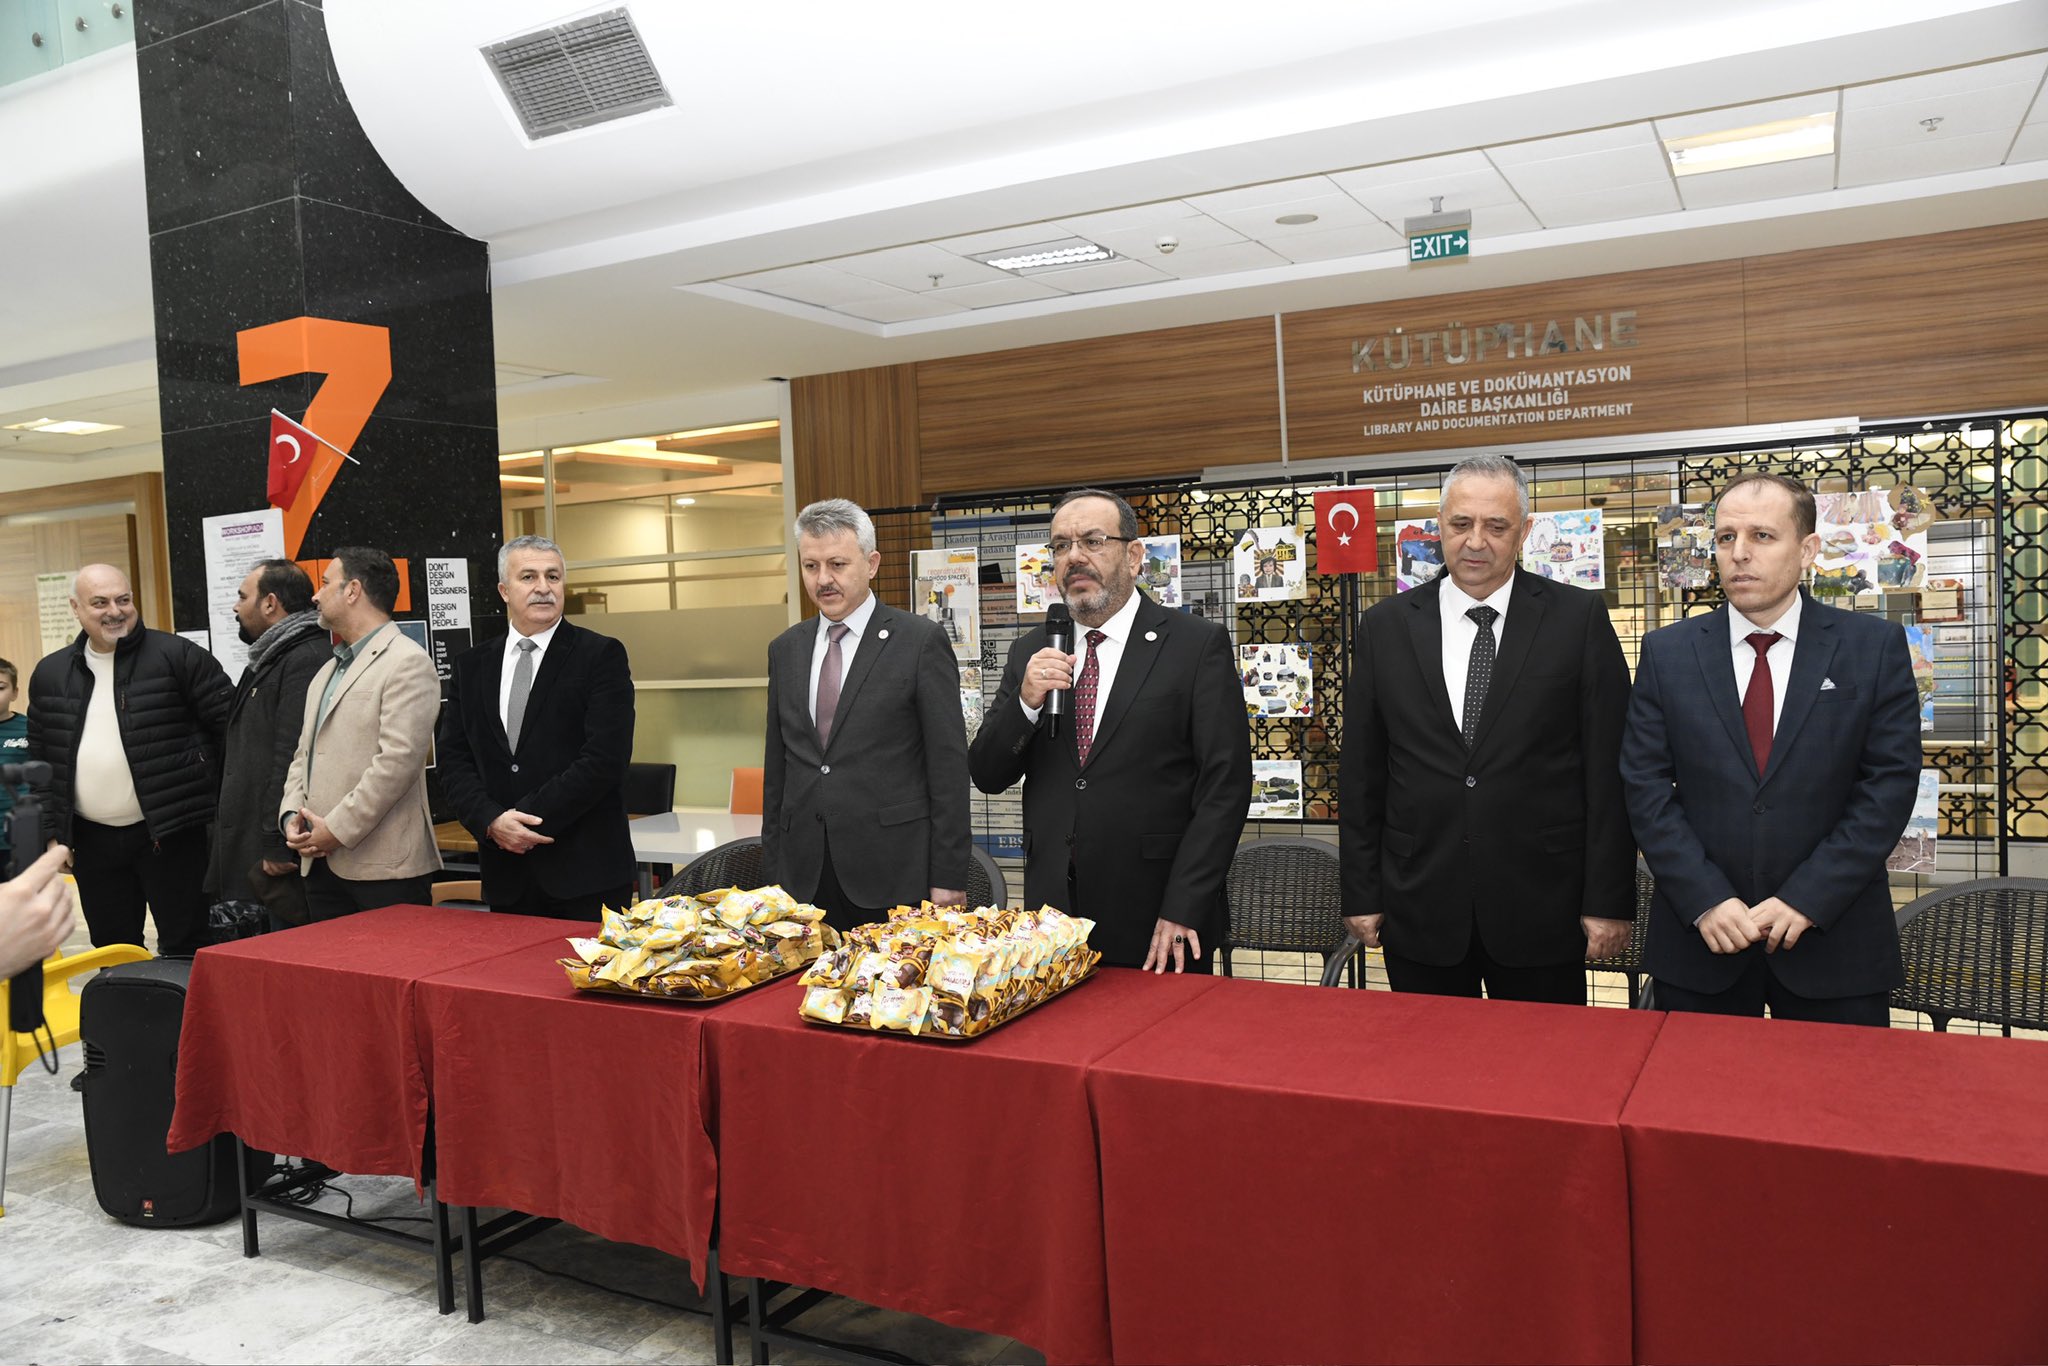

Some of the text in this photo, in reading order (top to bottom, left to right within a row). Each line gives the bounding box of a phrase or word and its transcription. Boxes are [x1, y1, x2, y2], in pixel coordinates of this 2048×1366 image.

[1411, 234, 1453, 259] EXIT
[1351, 310, 1638, 373] KÜTÜPHANE
[1363, 365, 1632, 404] KÜTÜPHANE VE DOKÜMANTASYON
[1420, 388, 1569, 417] DAİRE BAŞKANLIĞI
[1363, 403, 1633, 436] LIBRARY AND DOCUMENTATION DEPARTMENT
[428, 562, 449, 571] DON'T
[429, 571, 455, 579] DESIGN
[430, 579, 444, 587] FOR
[430, 586, 467, 595] DESIGNERS
[431, 603, 457, 611] DESIGN
[432, 611, 446, 619] FOR
[432, 618, 458, 627] PEOPLE
[998, 836, 1024, 849] EBS
